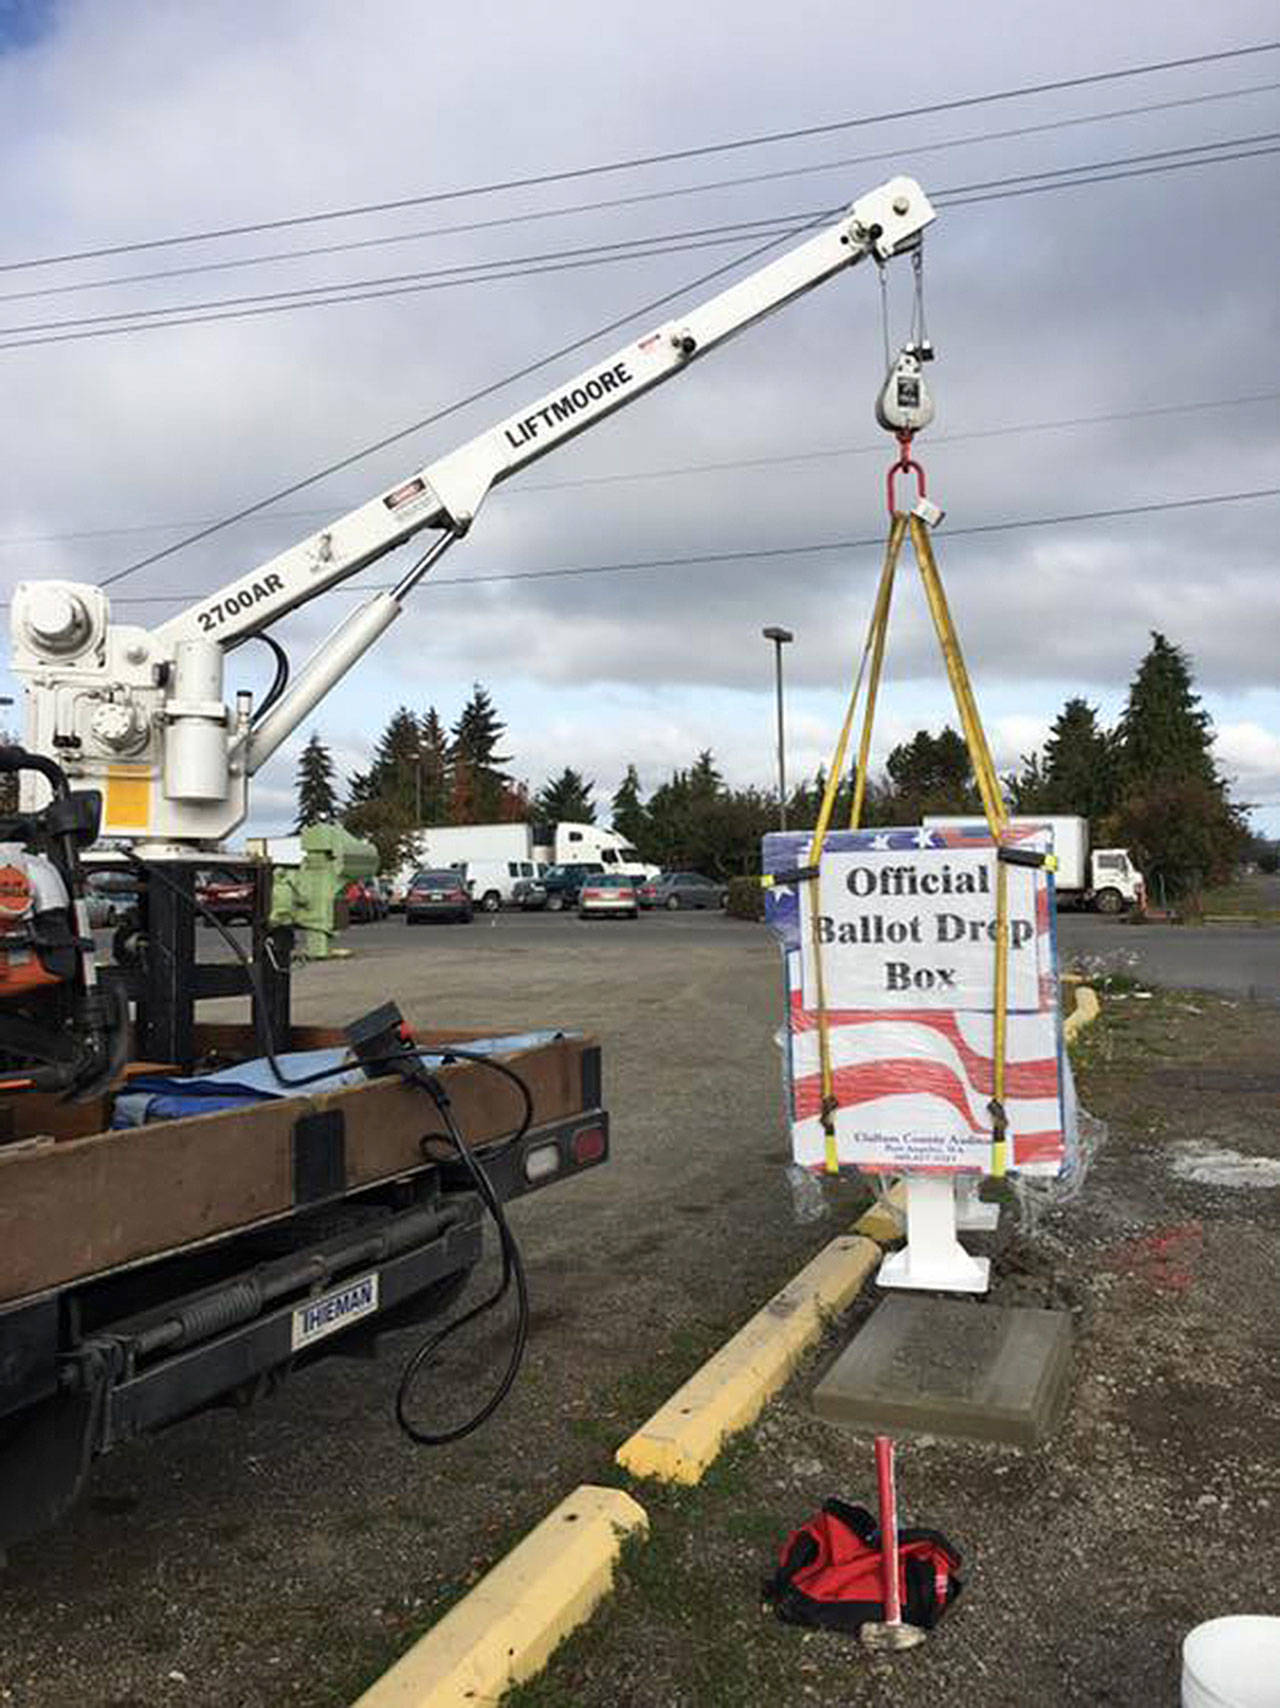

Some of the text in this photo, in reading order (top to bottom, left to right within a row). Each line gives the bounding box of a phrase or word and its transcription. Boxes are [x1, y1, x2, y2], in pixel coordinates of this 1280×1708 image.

[504, 362, 634, 449] LIFTMOORE
[197, 572, 285, 632] 2700AR
[845, 864, 990, 898] Official
[810, 913, 922, 944] Ballot
[884, 961, 958, 991] Box
[298, 1278, 372, 1333] THIEMAN
